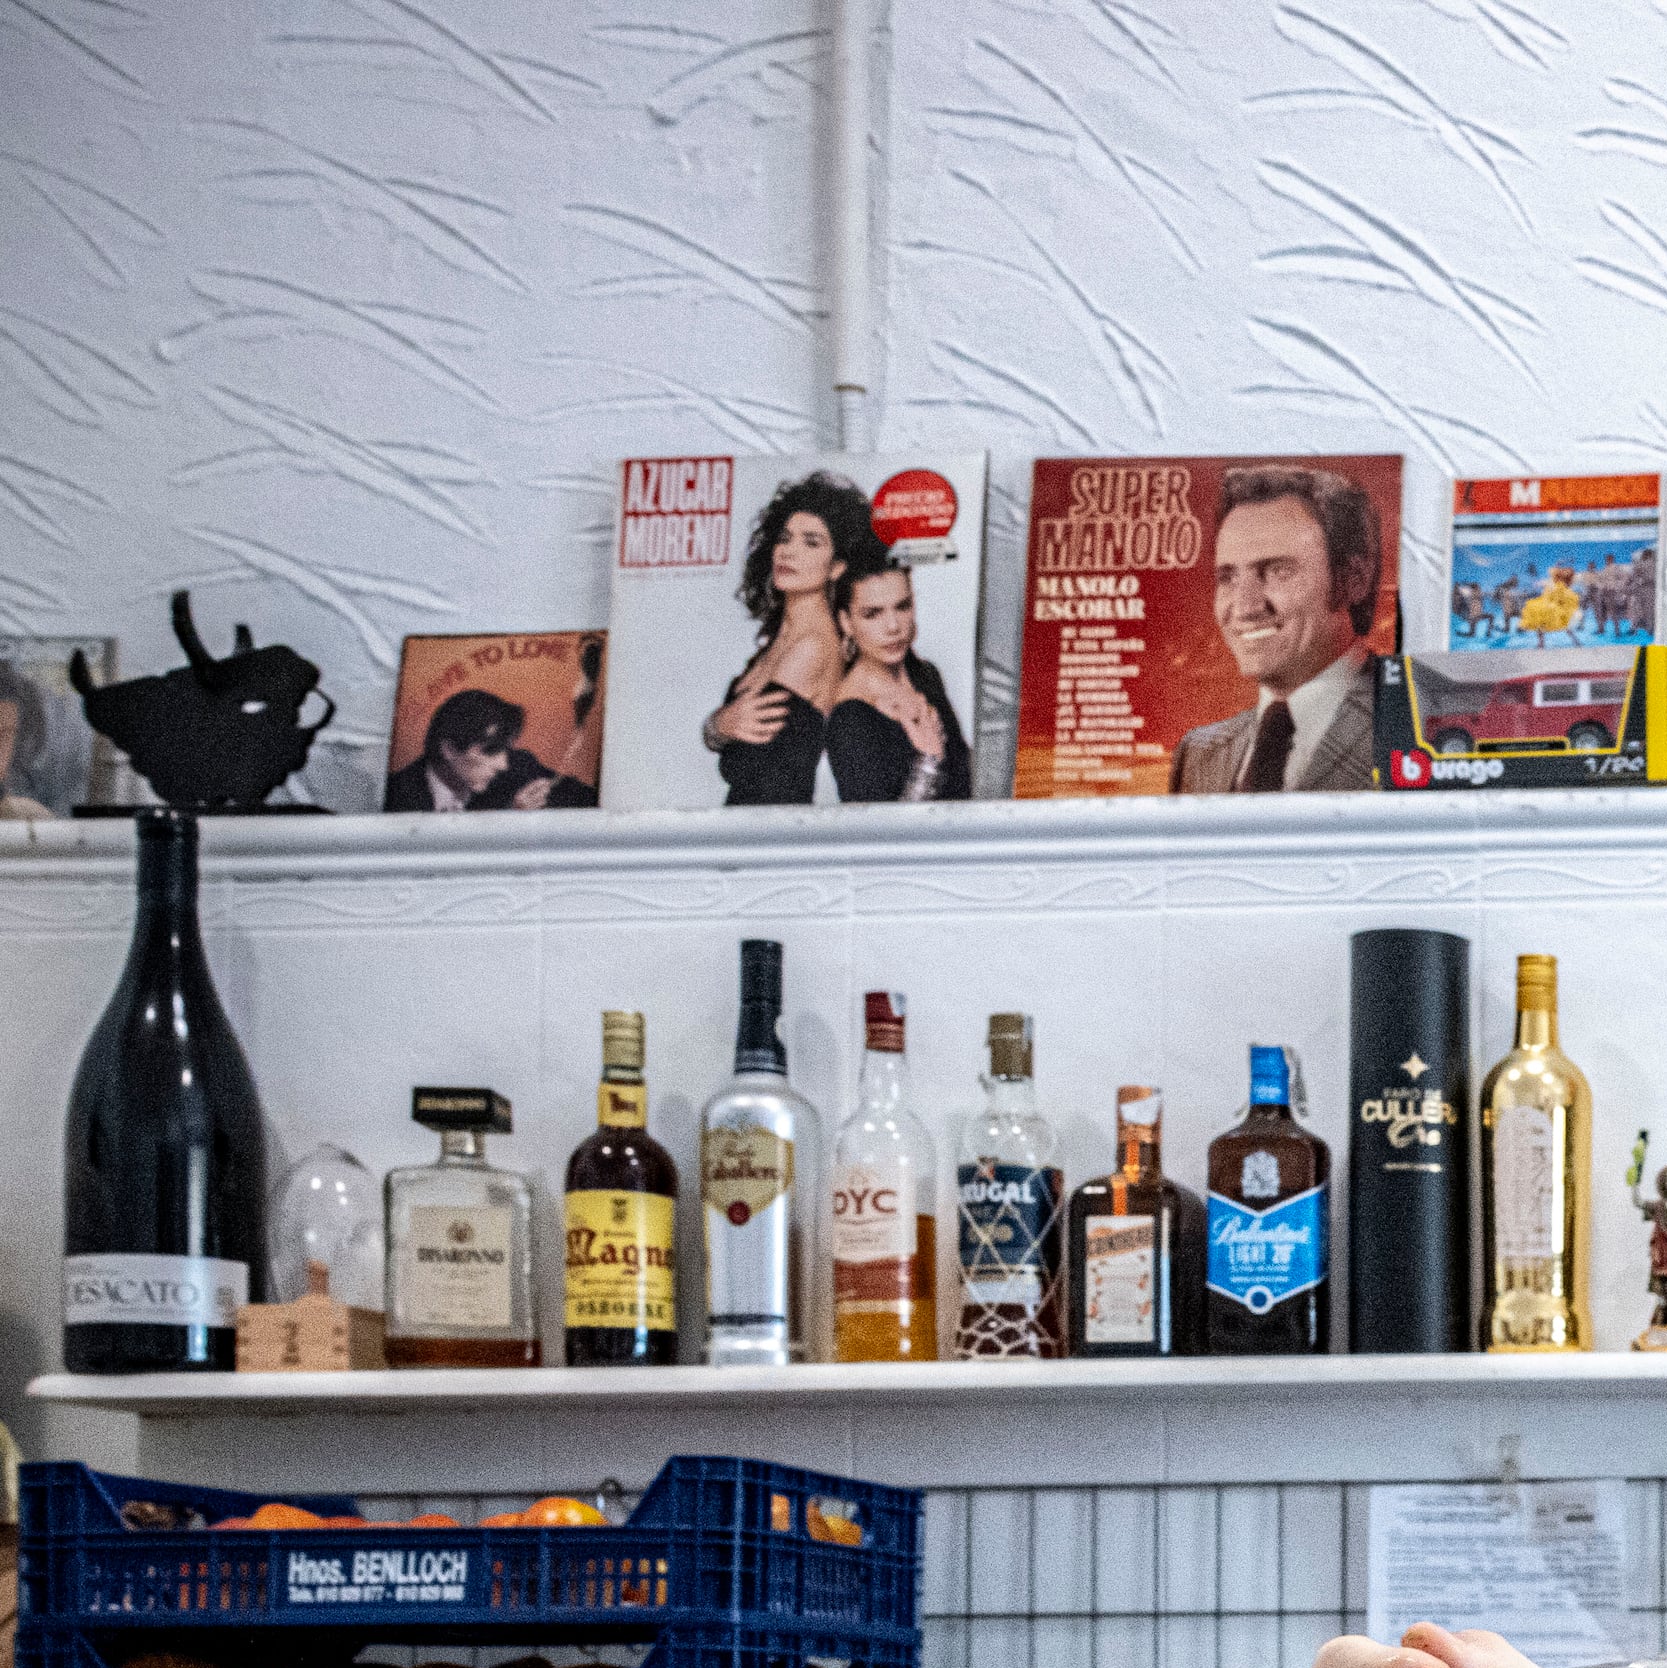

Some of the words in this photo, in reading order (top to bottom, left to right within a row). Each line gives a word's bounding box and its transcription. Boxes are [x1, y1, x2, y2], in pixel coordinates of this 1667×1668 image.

[626, 459, 731, 512] AZUCAR
[1069, 466, 1192, 517] SUPER
[1509, 479, 1541, 507] M
[623, 513, 731, 564] MORENO
[1037, 518, 1202, 571] MANOLO
[1037, 574, 1141, 597] MANOLO
[1034, 598, 1146, 621] ESCOBAR
[470, 645, 504, 668] TO
[508, 639, 573, 663] LOVE
[1361, 1100, 1456, 1125] CULLER
[957, 1179, 1038, 1204] RUGAL
[72, 1280, 200, 1306] ESACATO
[288, 1550, 347, 1585] Hnos.
[352, 1550, 468, 1585] BENLLOCH
